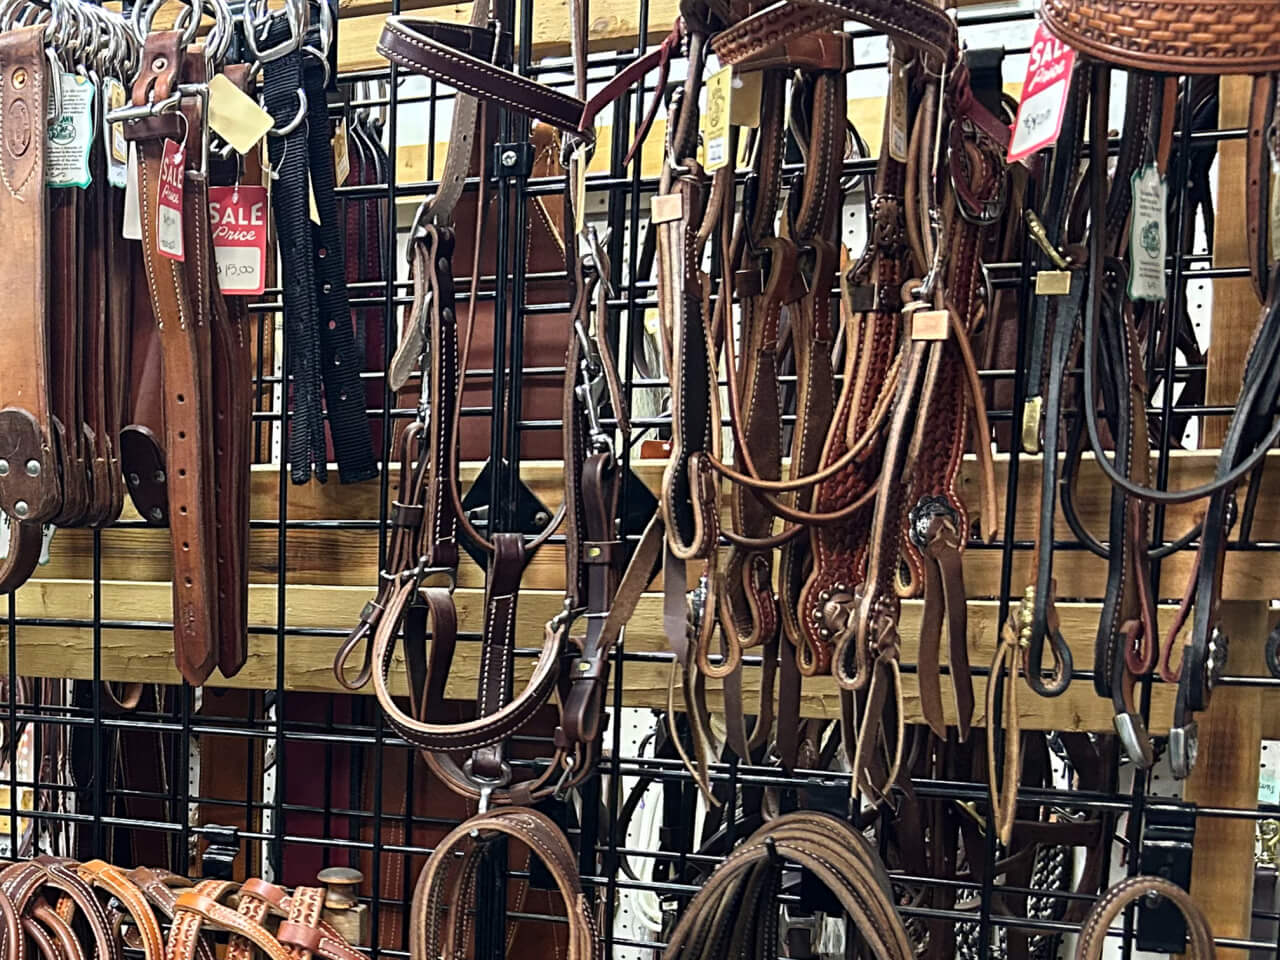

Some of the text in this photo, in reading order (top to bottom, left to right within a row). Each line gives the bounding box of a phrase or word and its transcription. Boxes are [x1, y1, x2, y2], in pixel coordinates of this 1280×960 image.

[1030, 38, 1070, 71] SAL
[162, 157, 183, 188] SALE
[162, 186, 179, 204] Price
[208, 202, 264, 226] SALE
[213, 226, 256, 241] Price
